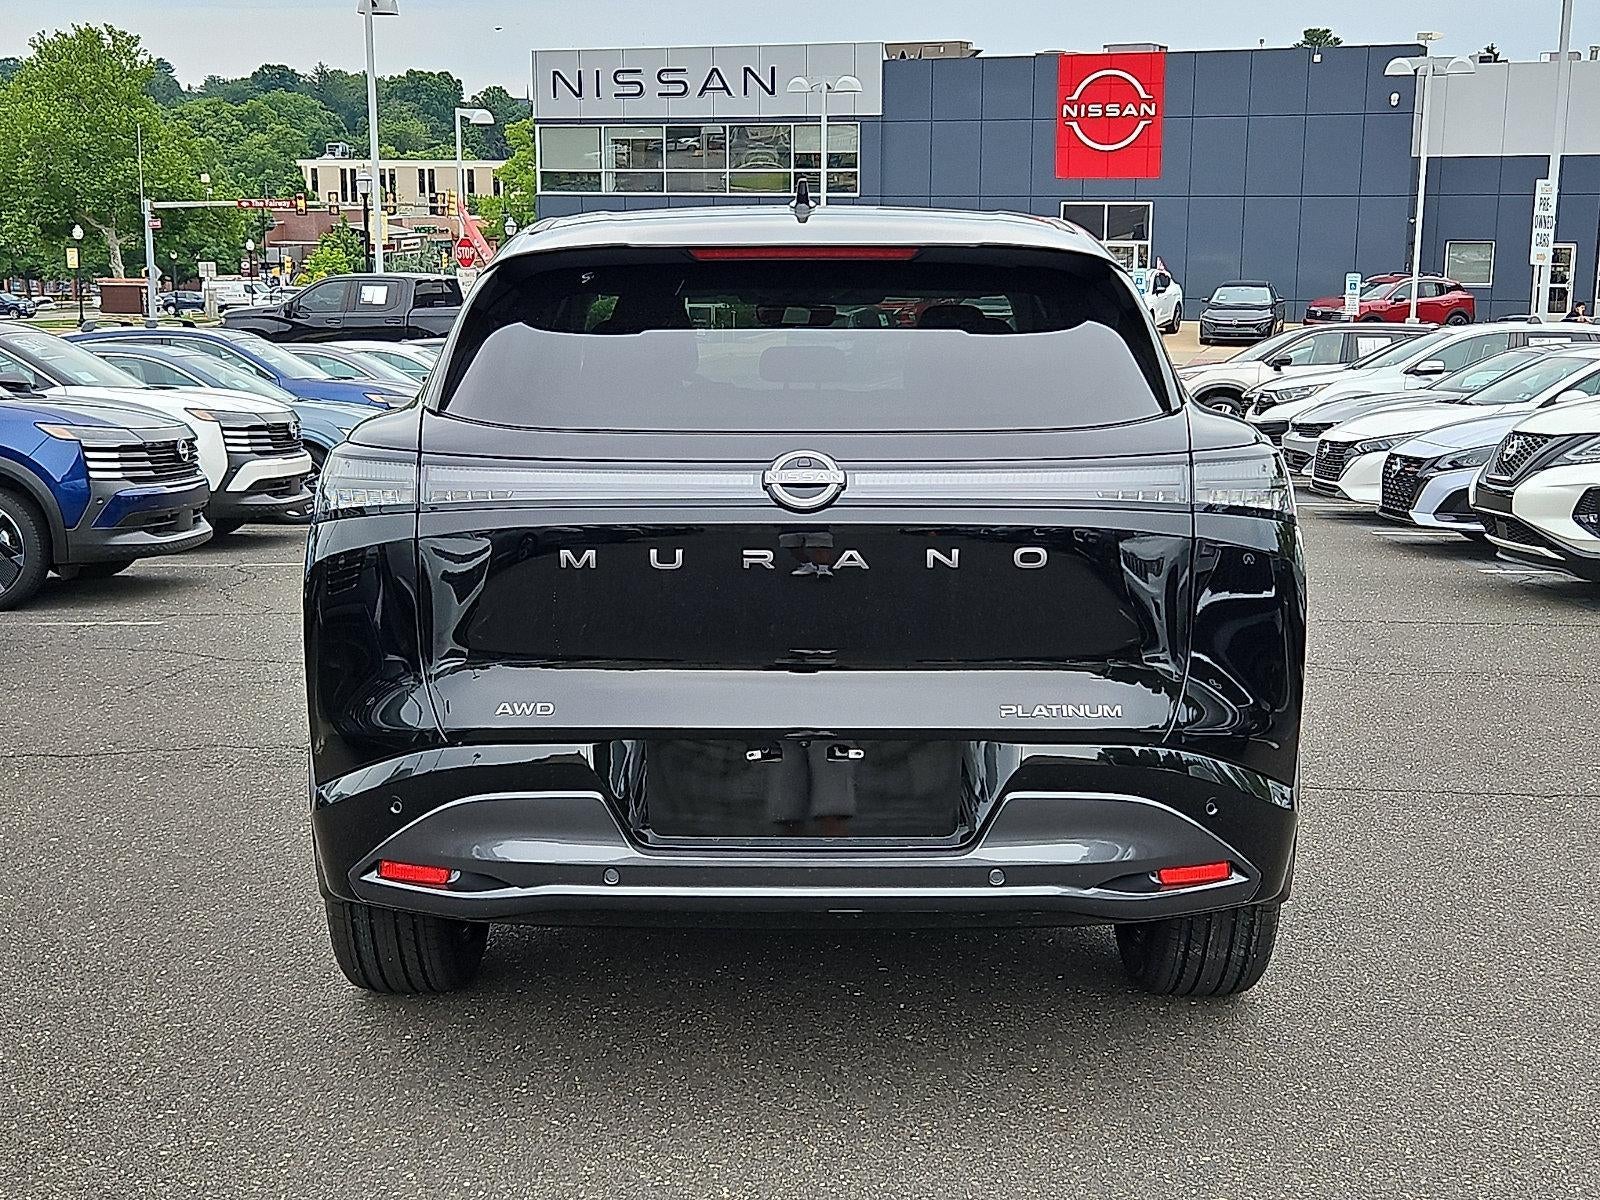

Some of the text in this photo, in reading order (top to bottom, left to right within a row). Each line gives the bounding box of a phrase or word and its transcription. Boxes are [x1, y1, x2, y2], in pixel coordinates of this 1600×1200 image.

[552, 65, 777, 98] NISSAN
[1062, 103, 1156, 117] NISSAN
[1535, 215, 1553, 229] OWNED
[1536, 233, 1549, 247] CARS
[457, 247, 474, 259] STOP
[767, 471, 840, 482] NISSAN
[559, 548, 1048, 569] MURANO
[494, 702, 555, 716] AWD
[1000, 704, 1122, 718] PLATINUM
